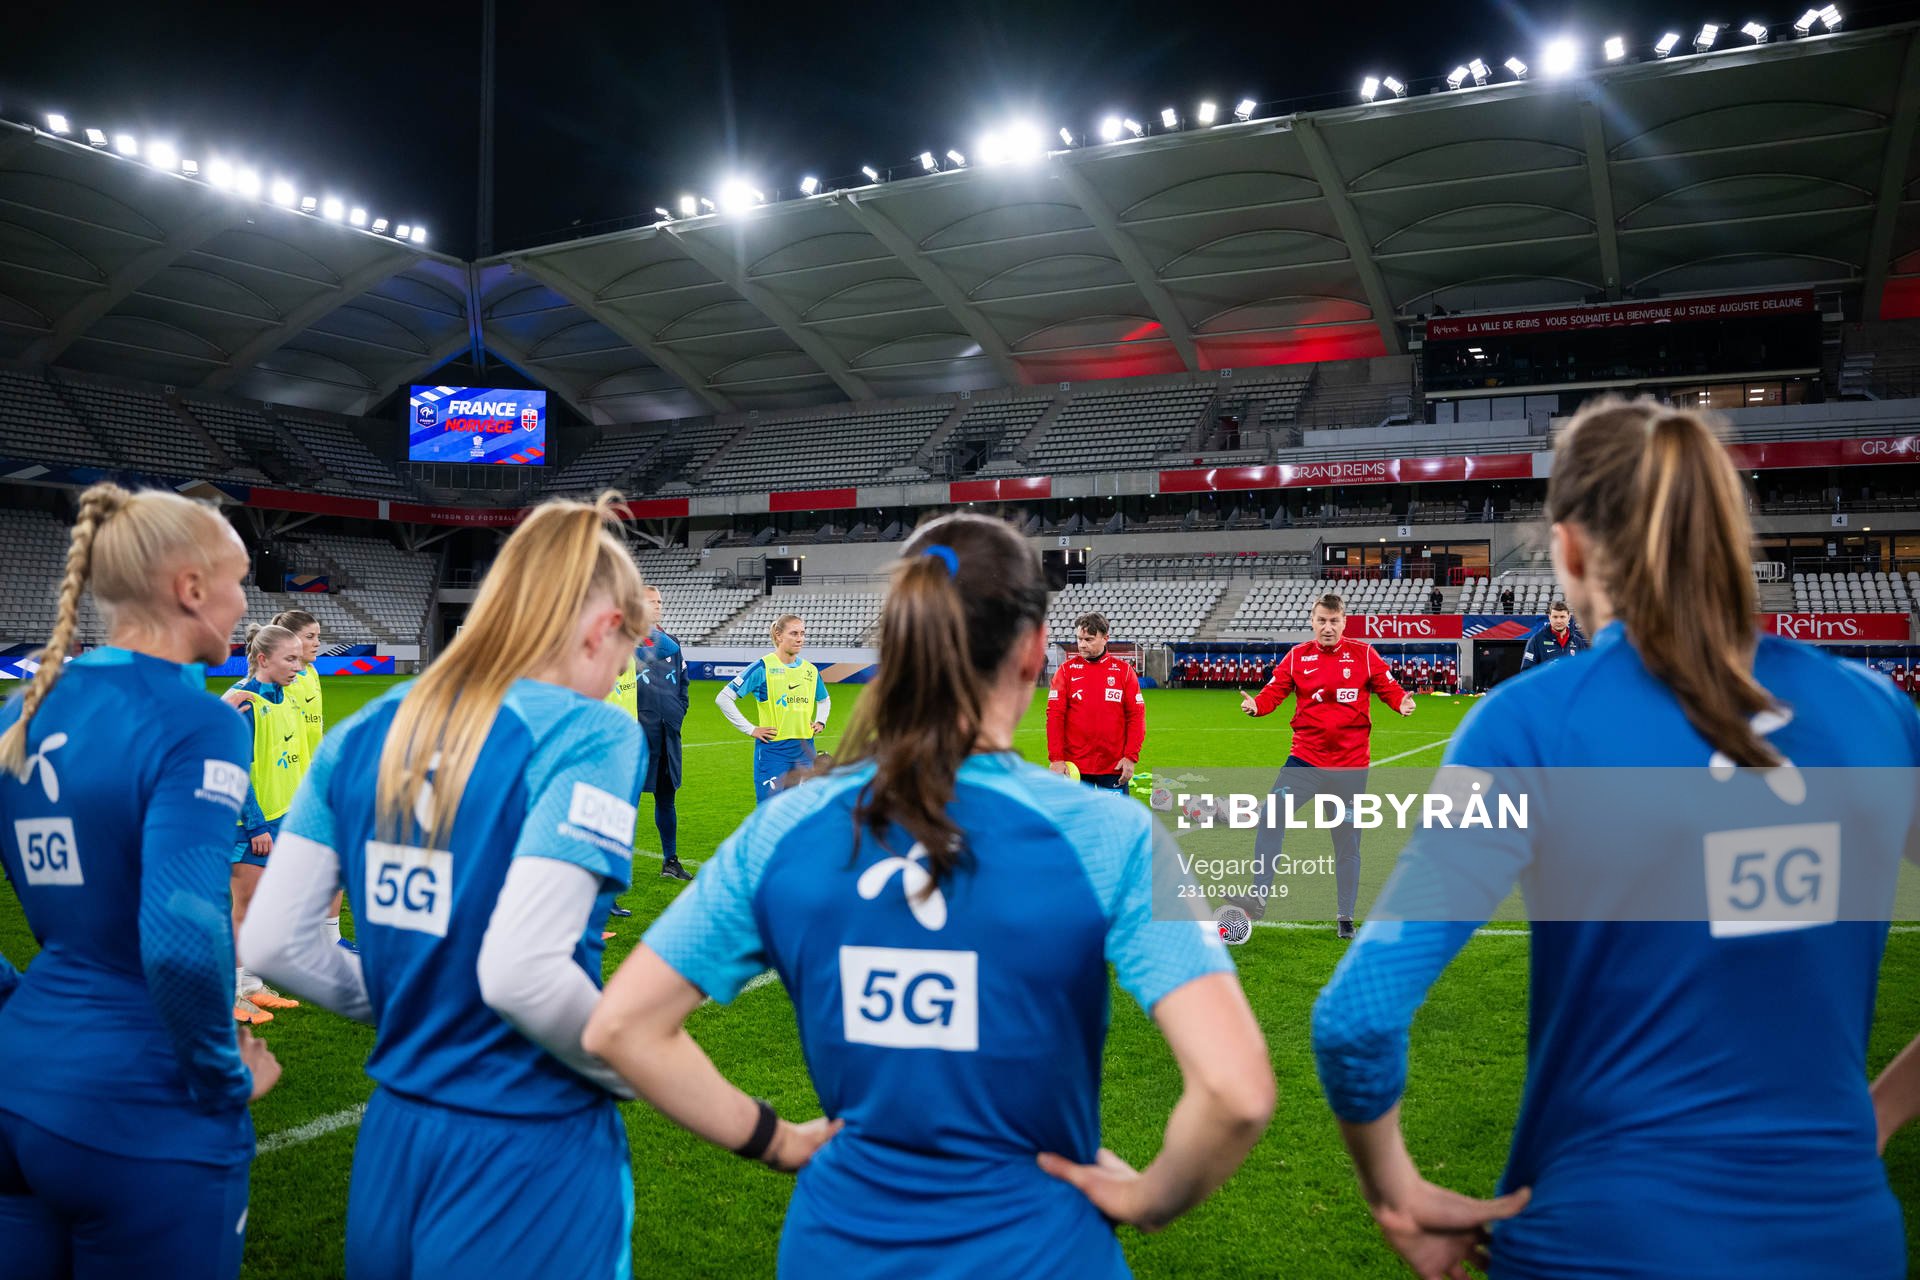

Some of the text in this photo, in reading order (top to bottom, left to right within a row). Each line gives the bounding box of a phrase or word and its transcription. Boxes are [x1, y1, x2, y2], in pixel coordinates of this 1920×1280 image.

[1467, 298, 1803, 332] LA VILLE DE REIMS VOUS SOUHAITE LA BIENVENUE AU STADE AUGUSTE DELAUNE
[448, 400, 518, 416] FRANCE
[445, 416, 514, 433] NORVÈGE
[1291, 463, 1385, 479] GRAND REIMS
[1107, 690, 1120, 700] 5G
[1339, 691, 1356, 700] 5G
[27, 832, 69, 871] 5G
[375, 862, 436, 914] 5G
[1728, 846, 1822, 912] 5G
[860, 969, 956, 1026] 5G
